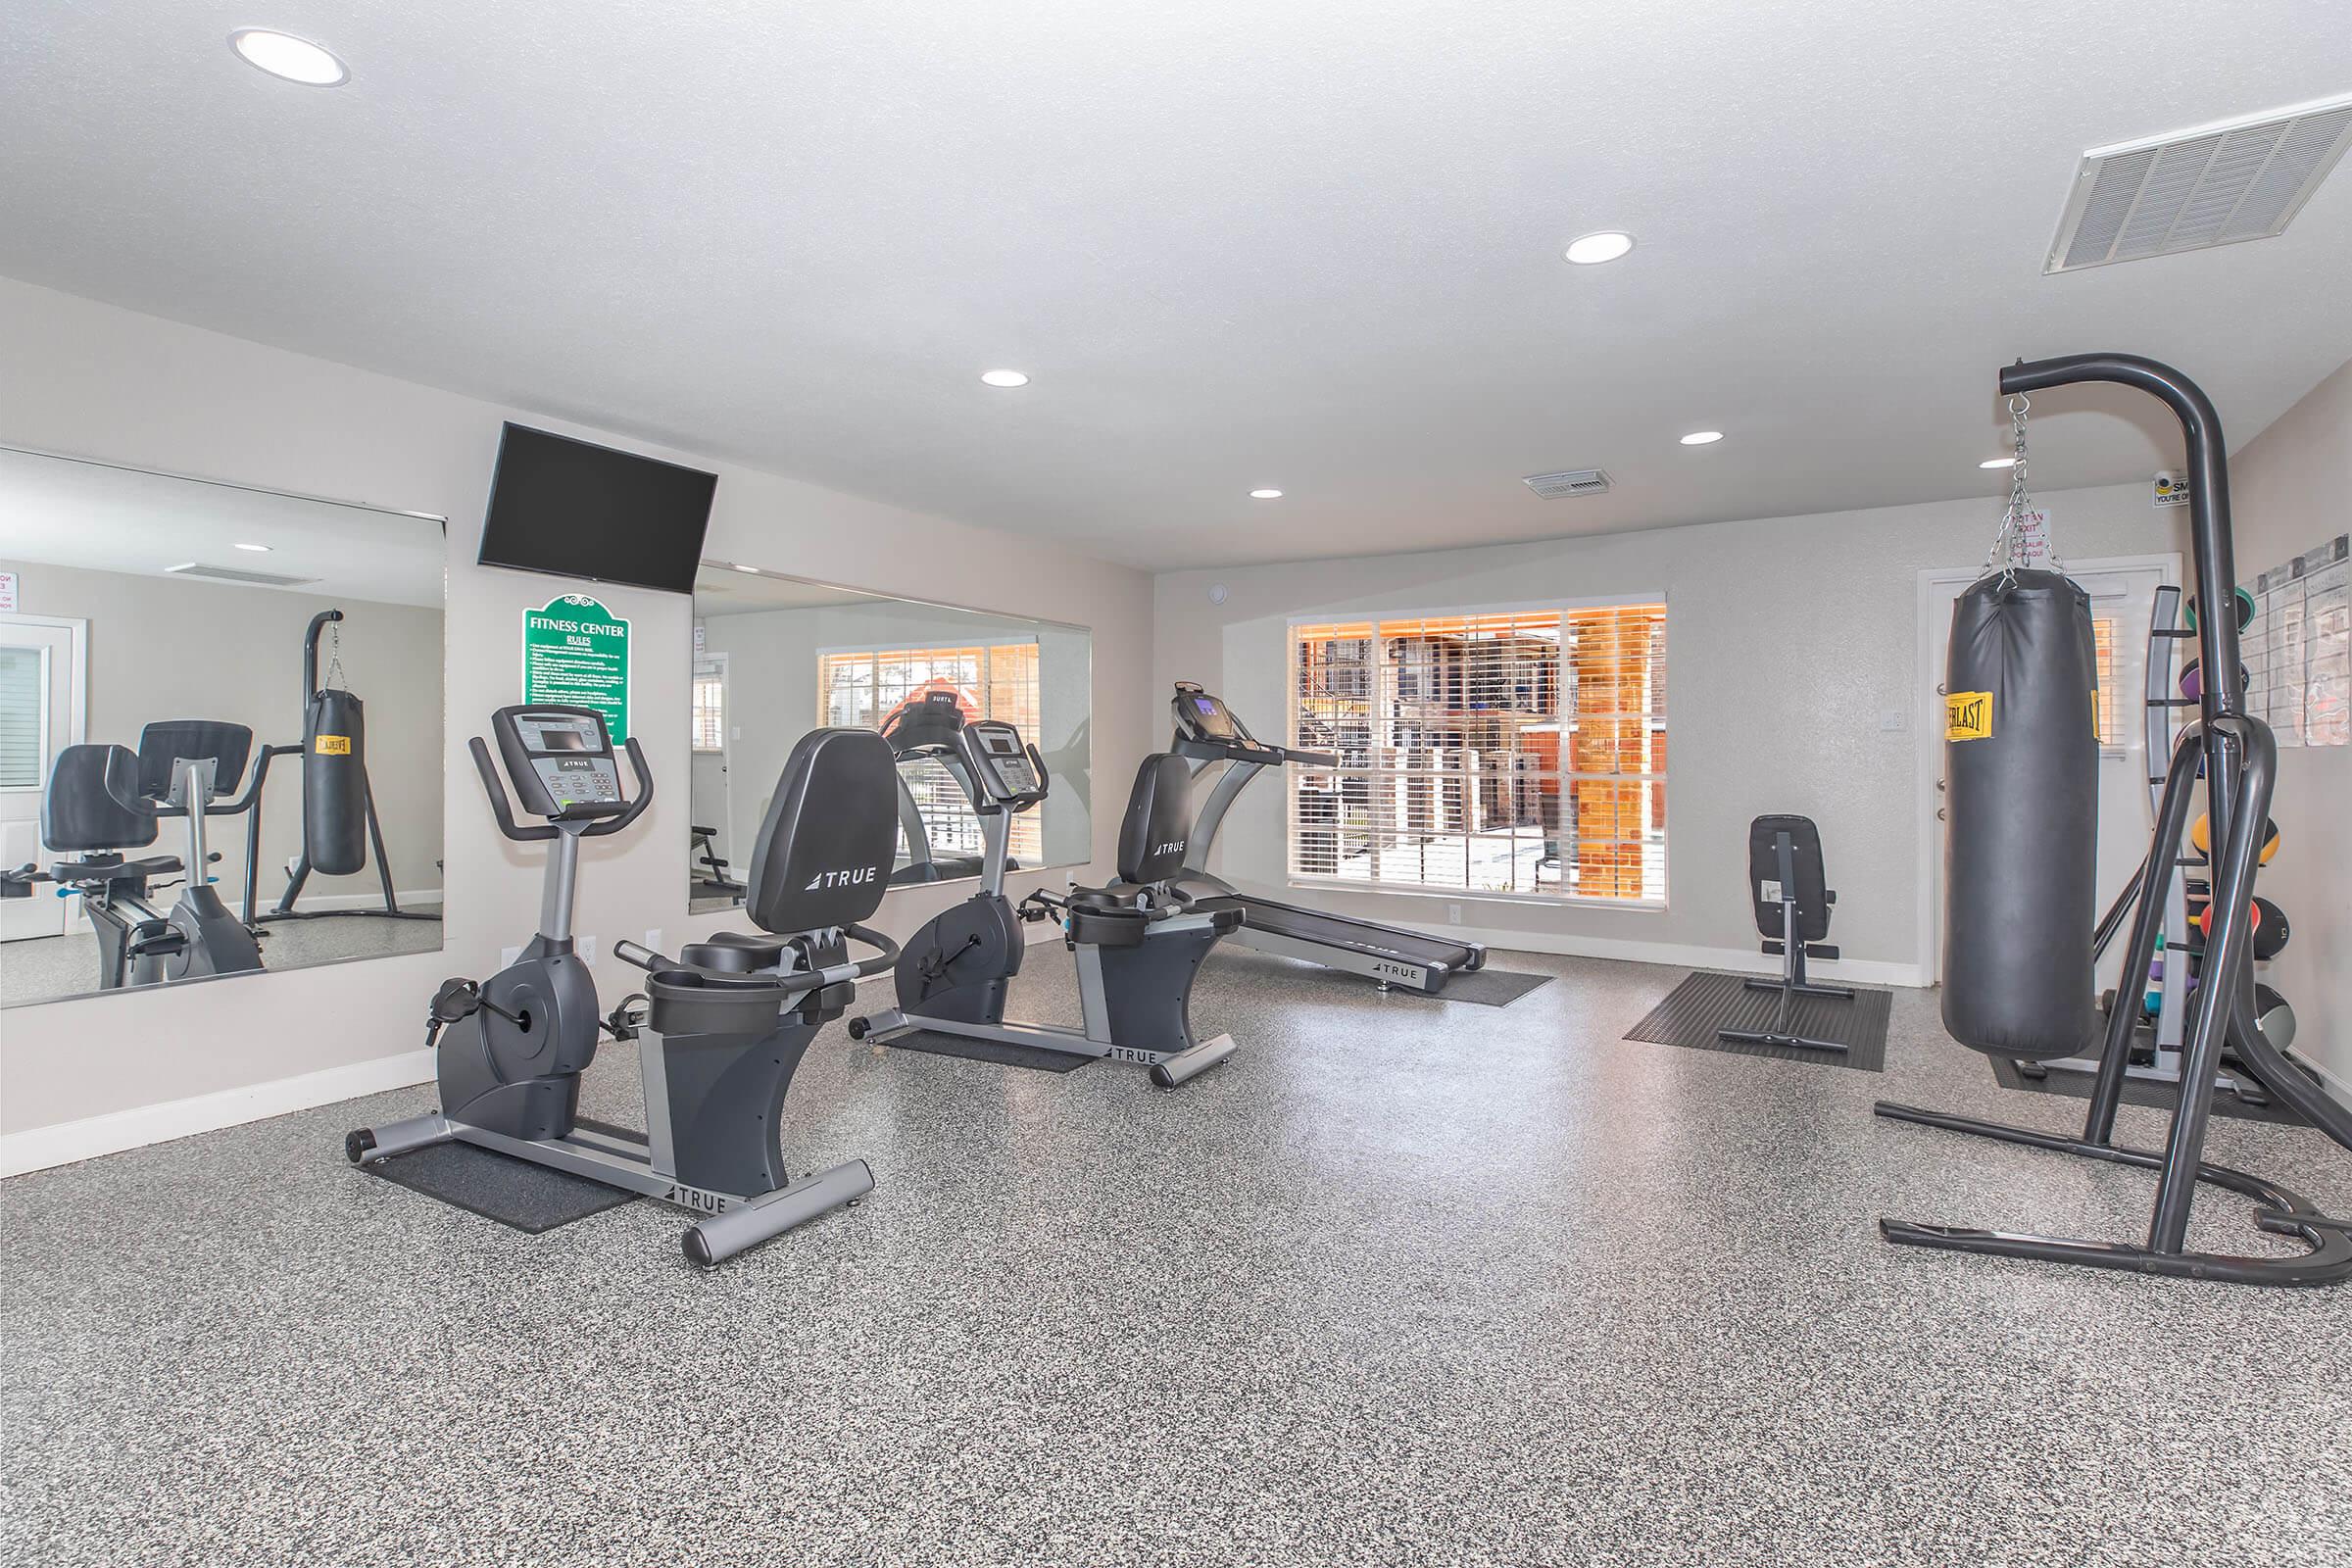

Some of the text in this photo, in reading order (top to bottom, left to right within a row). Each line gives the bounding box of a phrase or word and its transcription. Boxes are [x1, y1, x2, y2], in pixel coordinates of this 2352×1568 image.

[530, 616, 625, 637] FITNESS CENTER
[566, 635, 591, 645] RULES
[1162, 841, 1185, 855] TRUE
[825, 866, 876, 888] TRUE
[1384, 963, 1418, 980] TRUE
[1115, 1048, 1156, 1064] TRUE
[679, 1187, 726, 1214] TRUE
